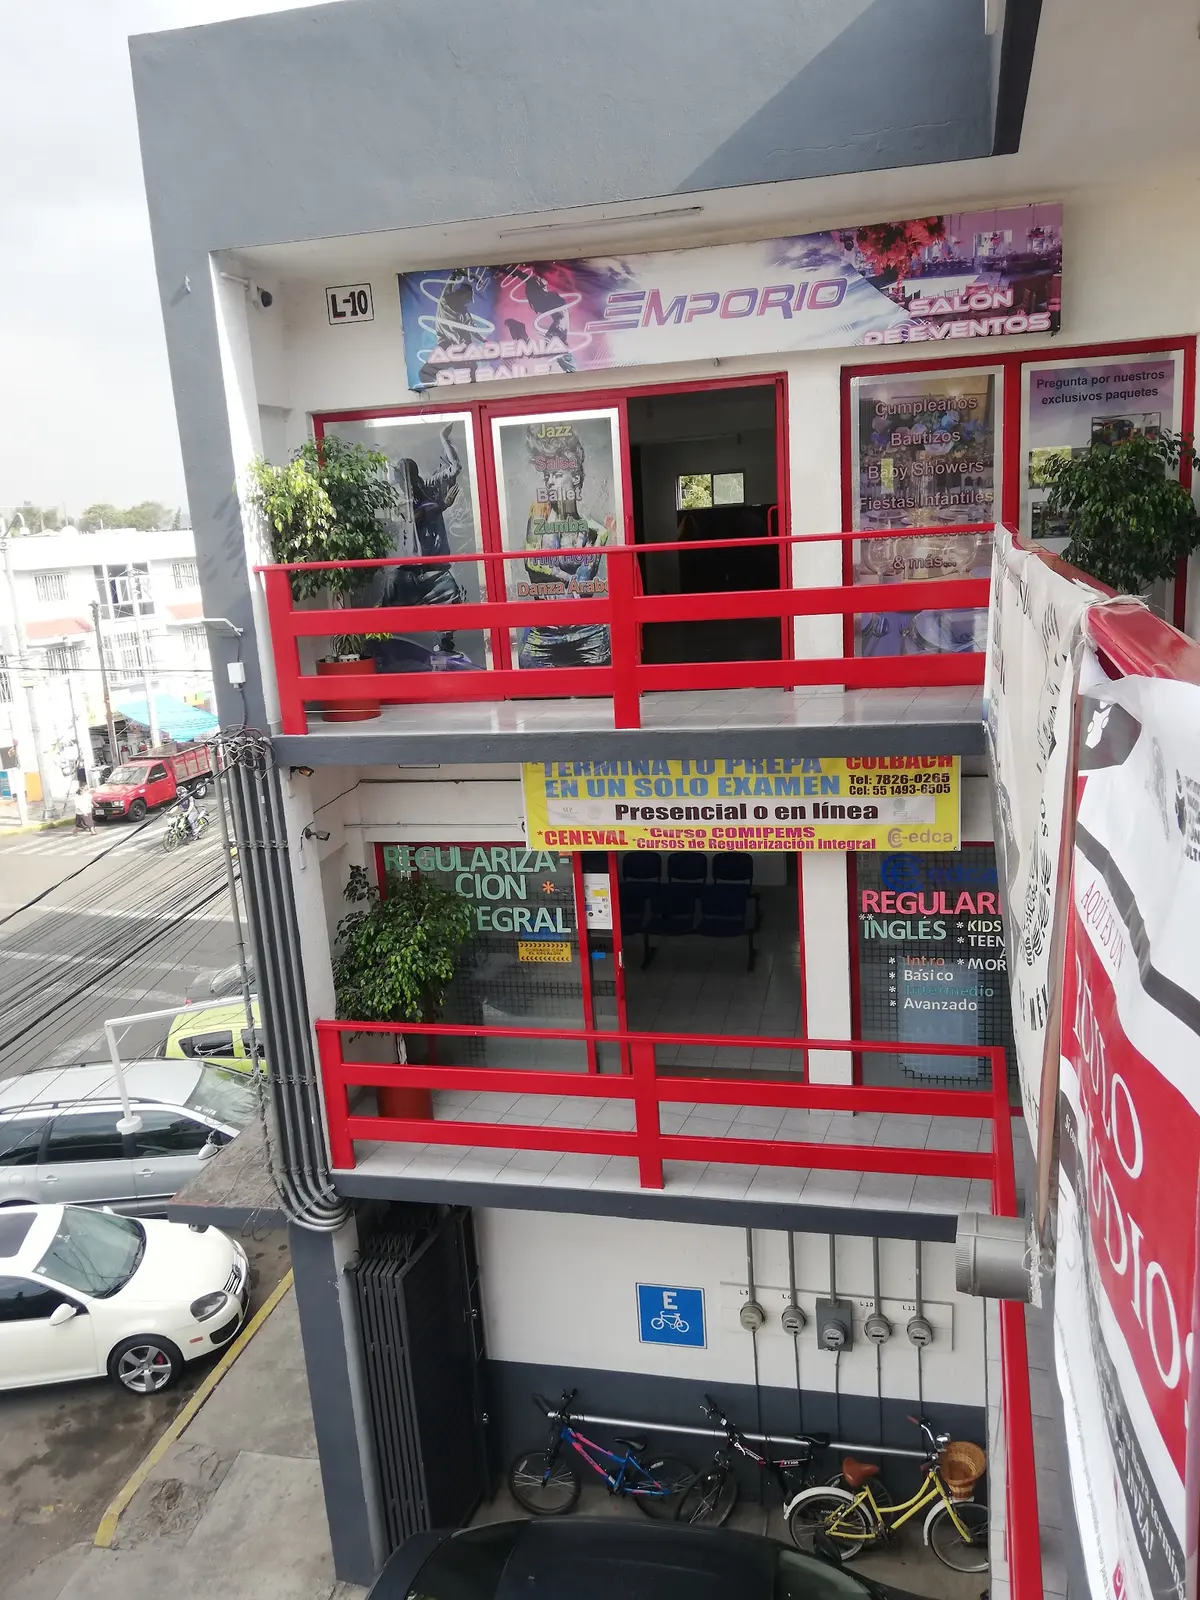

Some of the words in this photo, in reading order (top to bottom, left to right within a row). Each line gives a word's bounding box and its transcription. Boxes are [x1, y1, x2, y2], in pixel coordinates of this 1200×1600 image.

[331, 290, 368, 318] L-10
[586, 277, 848, 332] EMPORIO
[864, 331, 903, 345] DE
[908, 312, 1050, 342] EVENTOS
[427, 336, 569, 364] ACADEMIA
[436, 367, 472, 386] DE
[1036, 376, 1088, 390] Pregunta
[1091, 374, 1110, 387] por
[1114, 370, 1165, 383] nuestros
[1041, 391, 1103, 405] exclusivos
[1105, 387, 1158, 402] paquetes
[875, 396, 978, 417] Cumpleaños
[537, 423, 572, 438] Jazz
[891, 431, 961, 448] Bautizos
[535, 455, 577, 471] Salsa
[868, 464, 908, 481] Baby
[912, 461, 984, 477] Showers
[536, 486, 582, 503] Ballet
[859, 494, 915, 511] Fiestas
[919, 490, 994, 508] Infantiles
[534, 519, 588, 535] Zumba
[517, 582, 565, 597] Danza
[544, 760, 671, 777] TERMINA
[681, 759, 716, 776] TU
[725, 757, 822, 775] PREPA
[846, 755, 953, 770] COLBACH
[545, 779, 578, 798] EN
[587, 778, 626, 797] UN
[629, 777, 708, 797] SOLO
[718, 775, 840, 797] EXAMEN
[849, 774, 872, 784] Tel:
[876, 773, 950, 784] 7826-0265
[849, 785, 870, 795] Cel:
[873, 785, 887, 795] 55
[889, 783, 950, 795] 1493-6505
[615, 803, 747, 820] Presencial
[753, 806, 768, 820] o
[775, 804, 806, 820] en
[813, 801, 878, 820] línea
[650, 828, 707, 838] Curso
[712, 827, 815, 838] COMIPEMS
[637, 838, 685, 849] Cursos
[688, 838, 705, 849] de
[709, 838, 815, 850] Regularización
[818, 839, 875, 850] Integral
[456, 872, 527, 900] CION
[468, 906, 571, 933] EGRAL
[864, 915, 946, 940] INGLÉS
[968, 920, 1002, 932] KIDS
[906, 955, 945, 966] Intro
[904, 968, 954, 981] Básico
[905, 984, 994, 997] Intermedio
[904, 998, 978, 1011] Avanzado
[662, 1291, 677, 1310] E
